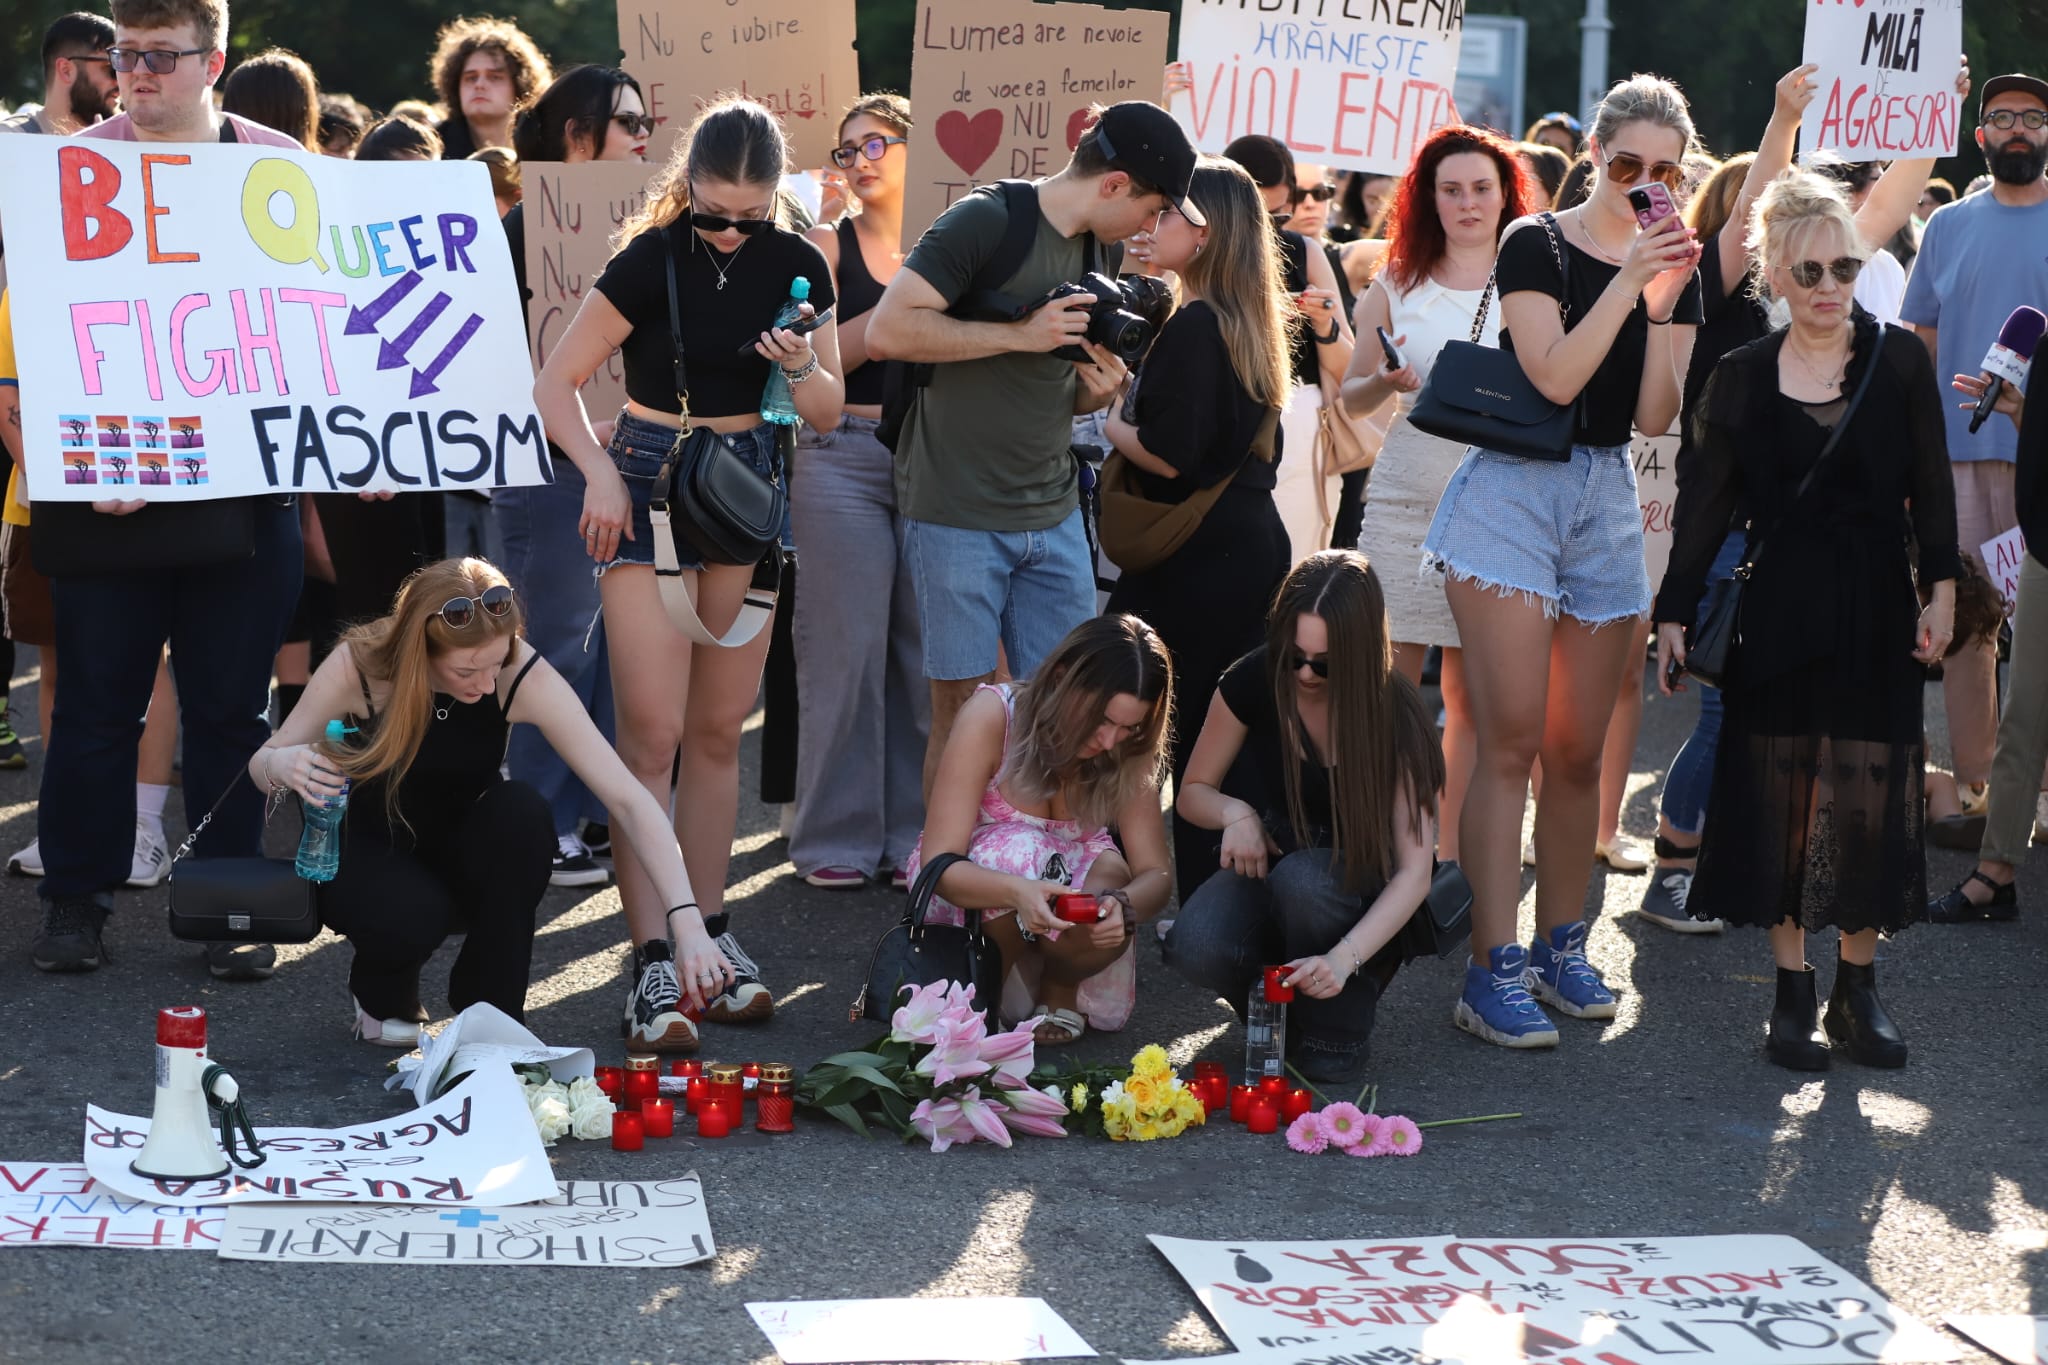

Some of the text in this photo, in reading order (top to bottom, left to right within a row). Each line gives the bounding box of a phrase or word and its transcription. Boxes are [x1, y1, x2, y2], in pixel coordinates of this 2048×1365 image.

[639, 12, 800, 60] Nu e iubire
[923, 6, 1143, 52] Lumea are nevoie
[1254, 21, 1430, 77] HRĂNEȘTE
[1861, 8, 1924, 72] MILĂ
[650, 83, 667, 120] E
[952, 67, 1136, 103] de vocea femeilor
[1874, 70, 1892, 97] DE
[1013, 101, 1051, 139] NU
[1817, 76, 1955, 152] AGRESORI
[1010, 147, 1049, 179] DE
[58, 146, 200, 264] BE
[540, 175, 582, 234] Nu
[542, 241, 582, 301] Nu
[69, 288, 347, 400] FIGHT
[1473, 386, 1511, 401] VALENTINO
[250, 405, 555, 490] FASCISM
[1210, 1280, 1509, 1307] AGRESOR
[1575, 1270, 1790, 1300] ACUZĂ
